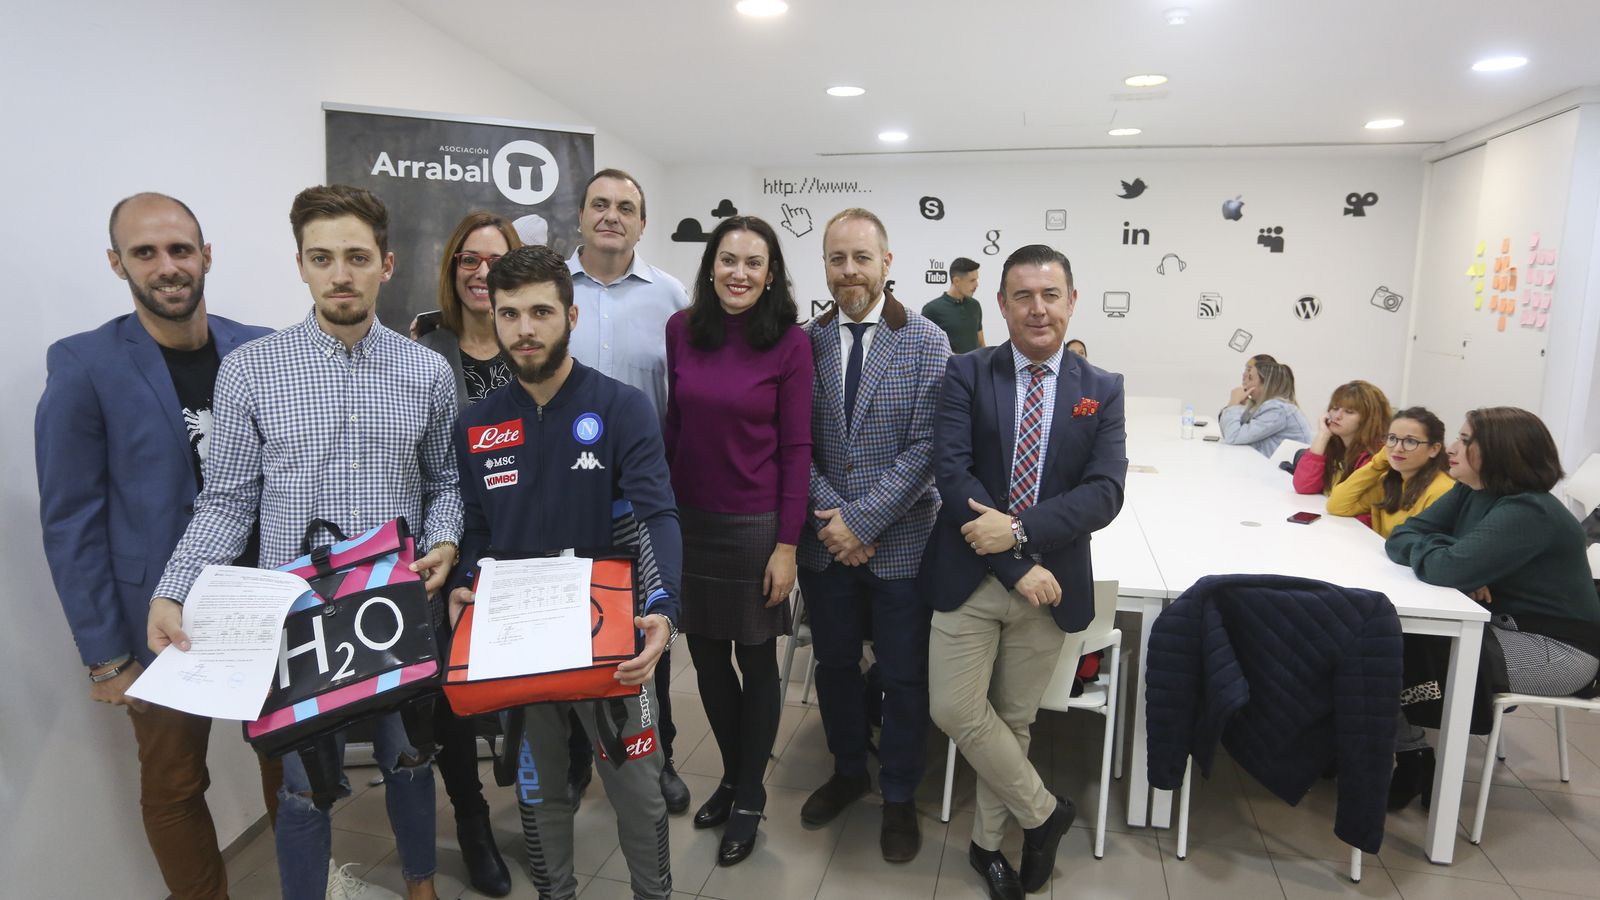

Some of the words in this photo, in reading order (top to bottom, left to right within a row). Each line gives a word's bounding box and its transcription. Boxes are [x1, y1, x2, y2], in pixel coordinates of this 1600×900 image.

[440, 145, 489, 155] ASOCIACIÓN
[371, 151, 489, 183] Arrabal
[1122, 221, 1150, 245] in
[929, 258, 945, 270] You
[926, 271, 947, 283] Tube
[472, 427, 520, 449] Lete
[493, 455, 515, 467] MSC
[486, 474, 517, 487] KIMBO
